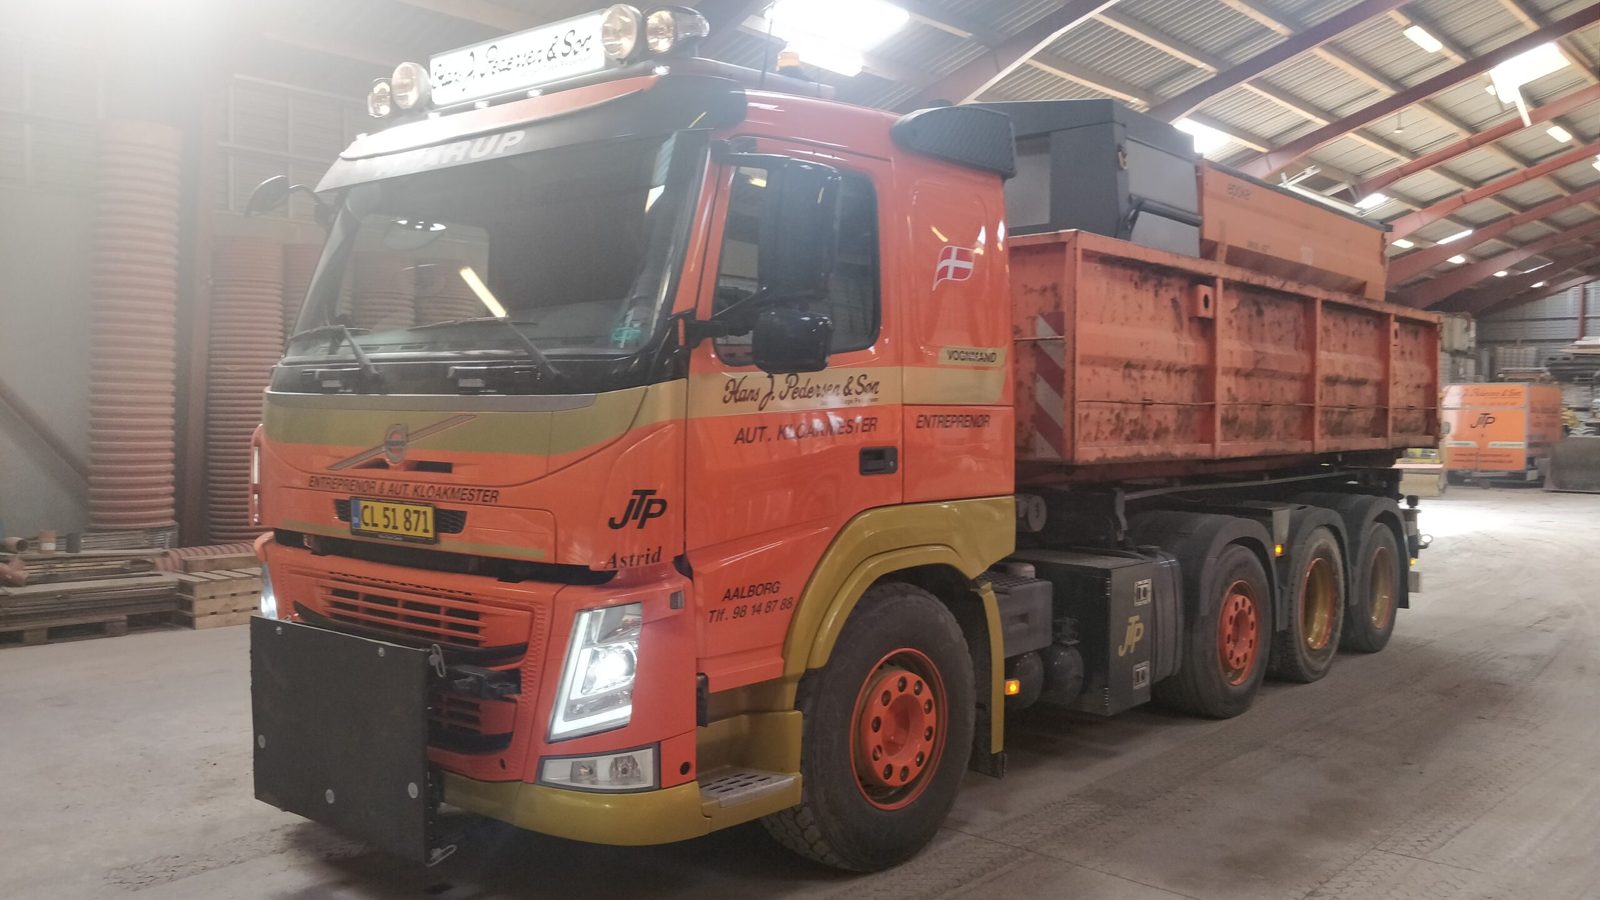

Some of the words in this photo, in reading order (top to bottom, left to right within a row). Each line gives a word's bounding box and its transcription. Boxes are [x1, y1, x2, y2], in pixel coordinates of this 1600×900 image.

[722, 375, 759, 404] Hans
[758, 372, 775, 411] J.
[779, 372, 840, 401] Pedersen
[843, 375, 855, 397] &
[1470, 412, 1496, 429] JTP
[734, 425, 771, 444] AUT.
[380, 481, 386, 494] &
[387, 483, 411, 497] AUT.
[413, 486, 500, 504] KLOAKMESTER
[361, 504, 378, 527] CL
[383, 506, 399, 530] 51
[403, 508, 431, 533] 871
[608, 489, 667, 530] JTP
[604, 545, 662, 570] Astrid
[721, 580, 781, 602] AALBORG
[732, 604, 747, 620] 98
[751, 602, 763, 616] 14
[765, 599, 779, 614] 87
[780, 596, 794, 611] 88
[1117, 614, 1145, 657] JTP
